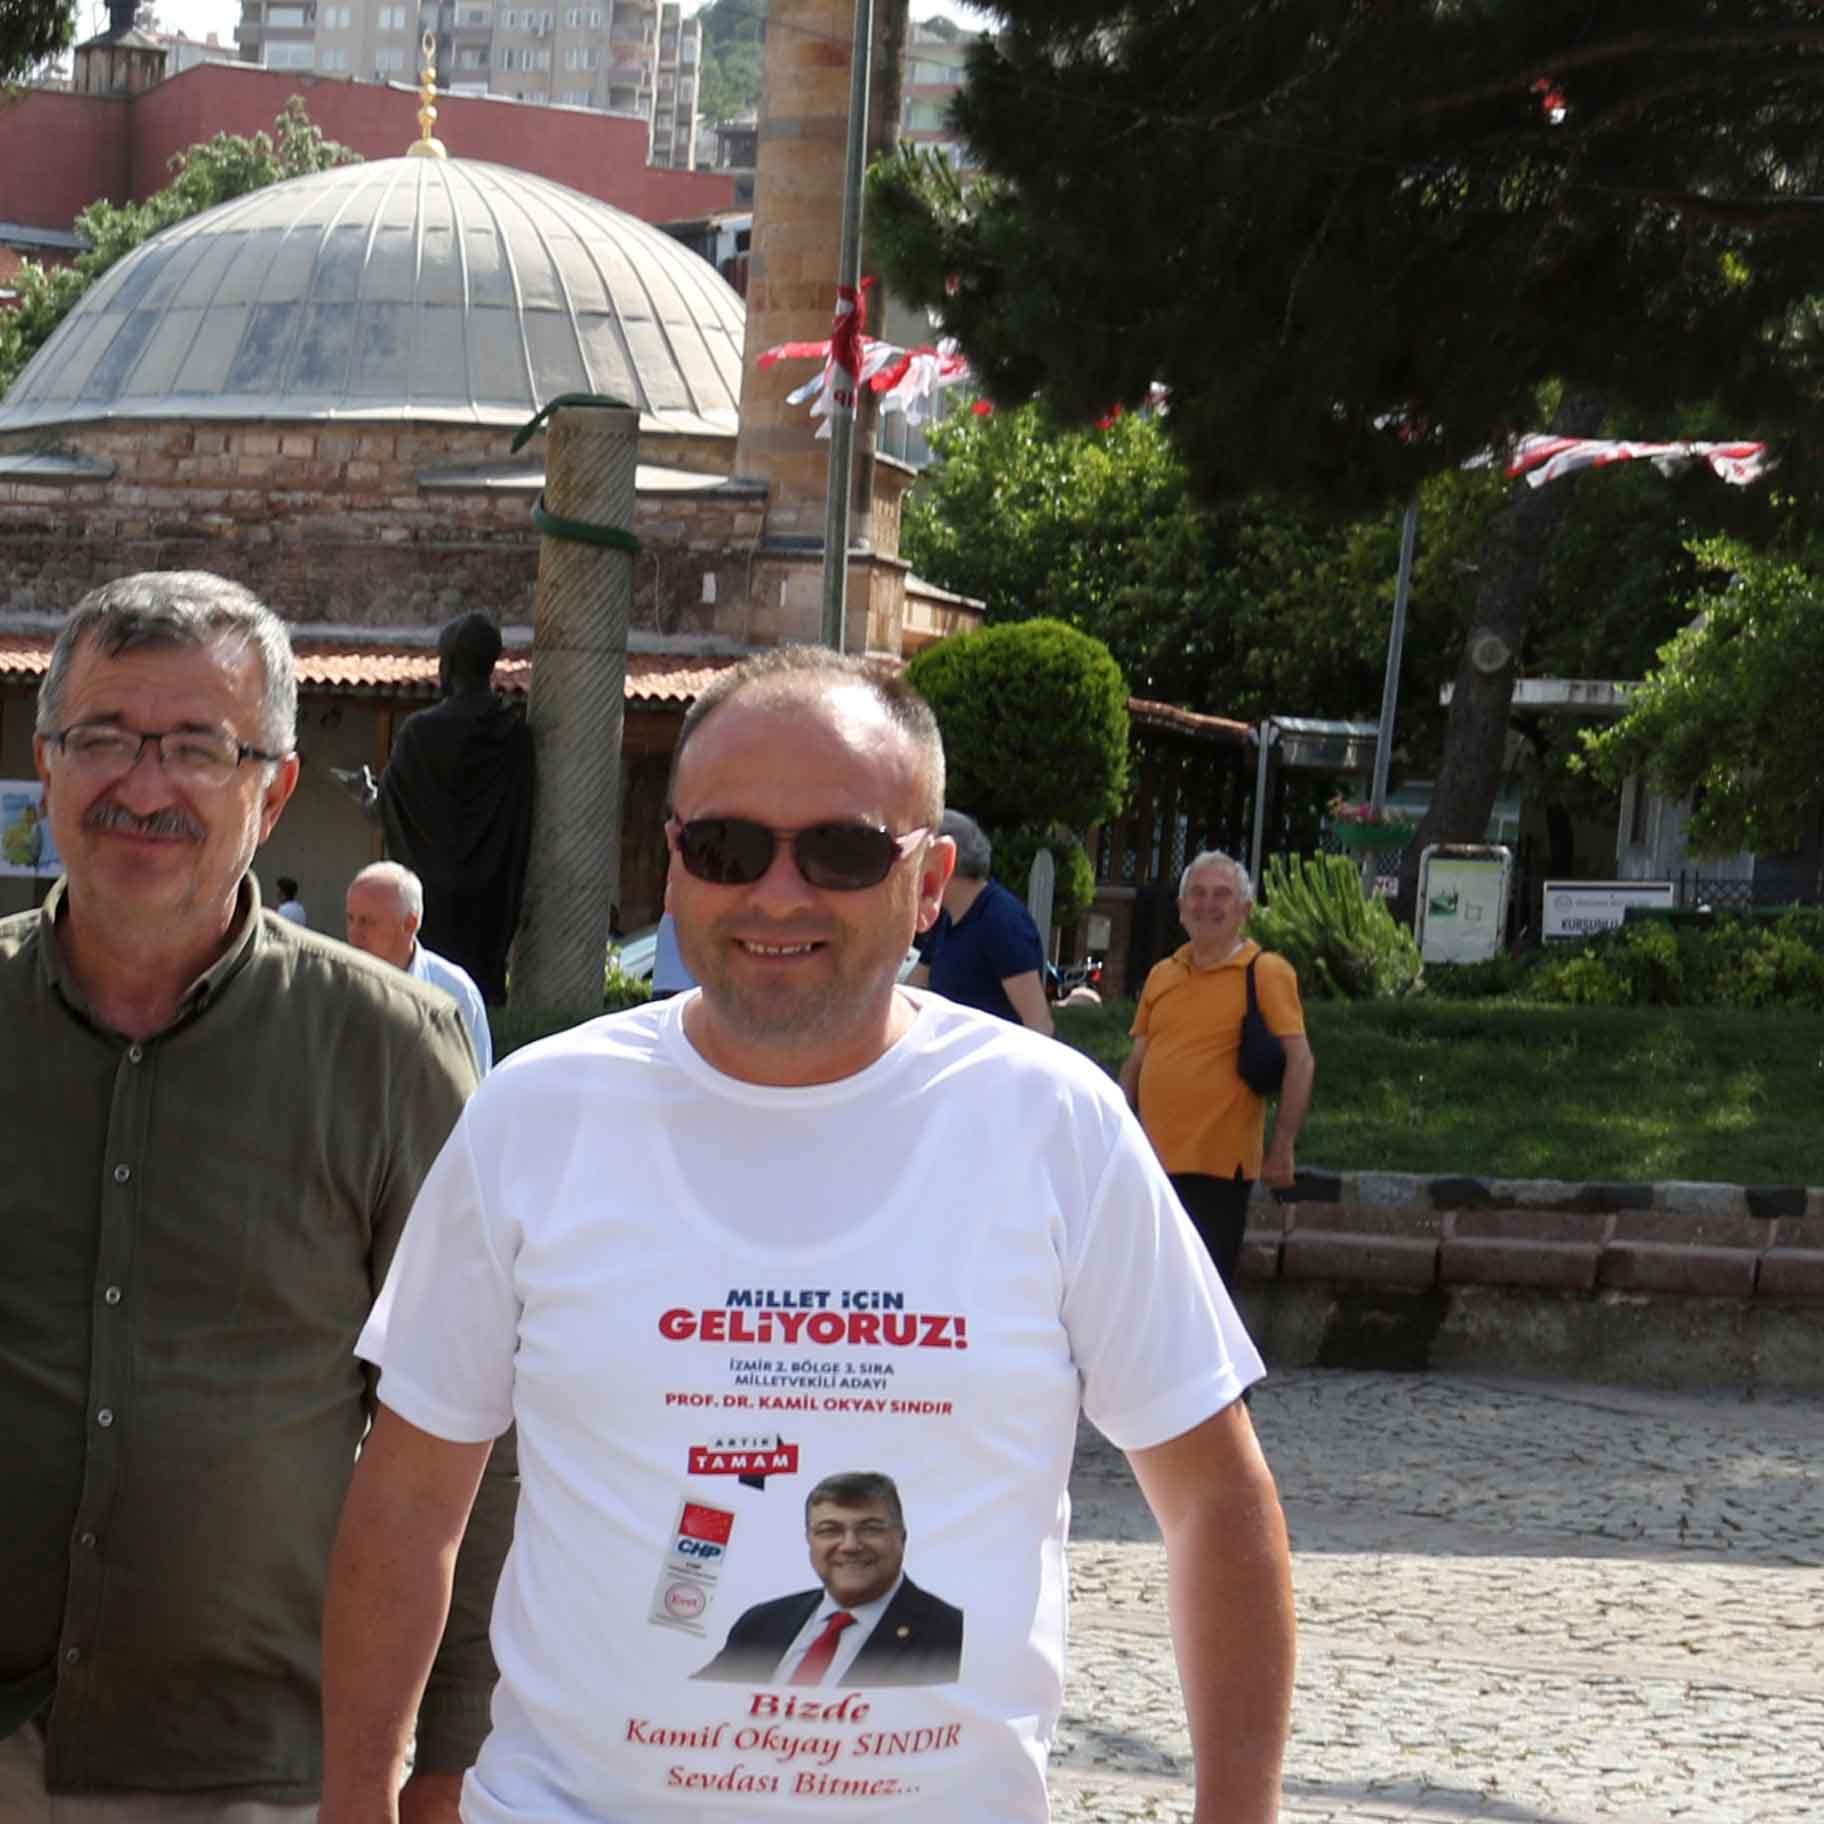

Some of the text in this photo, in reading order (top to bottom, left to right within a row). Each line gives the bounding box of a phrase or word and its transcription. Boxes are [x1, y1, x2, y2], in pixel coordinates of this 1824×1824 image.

[726, 1288, 904, 1311] MİLLET İÇİN
[658, 1307, 969, 1350] GELİYORUZ!
[729, 1358, 772, 1372] İZMİR
[791, 1360, 840, 1374] BÖLGE
[859, 1363, 895, 1376] SIRA
[734, 1372, 887, 1390] MİLLETVEKİLİ ADAYI
[665, 1392, 953, 1415] PROF. DR. KAMİL OKYAY SINDIR
[715, 1437, 769, 1447] ARTIK
[696, 1454, 789, 1469] TAMAM
[677, 1538, 721, 1559] CHP
[748, 1692, 871, 1724] Bizde
[624, 1717, 962, 1766] Kamil Okyay SINDIR
[666, 1763, 780, 1794] Sevdası
